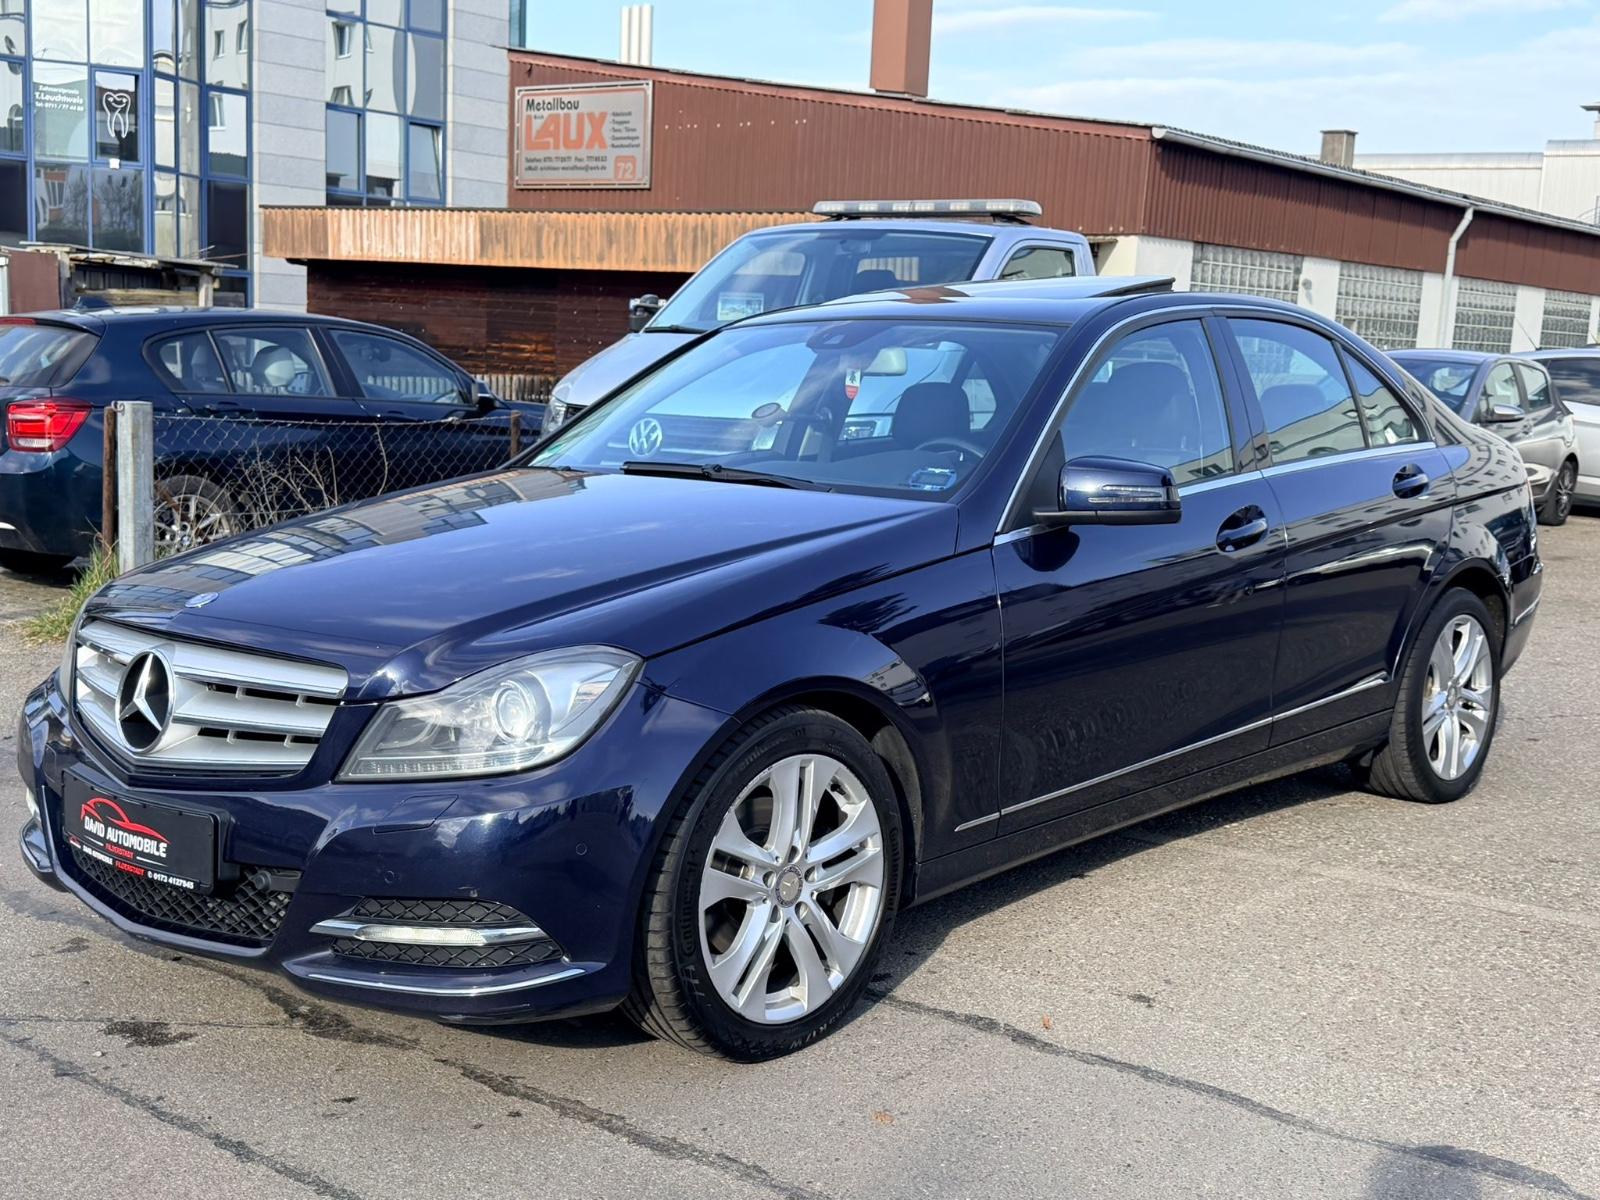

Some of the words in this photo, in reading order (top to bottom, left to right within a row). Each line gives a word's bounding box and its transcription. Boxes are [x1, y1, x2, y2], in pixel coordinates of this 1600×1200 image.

[526, 98, 580, 112] Metallbau
[525, 112, 609, 151] LAUX
[617, 162, 634, 179] 72
[84, 815, 105, 838] DAVID
[106, 826, 168, 858] AUTOMOBILE
[153, 872, 168, 883] 0173
